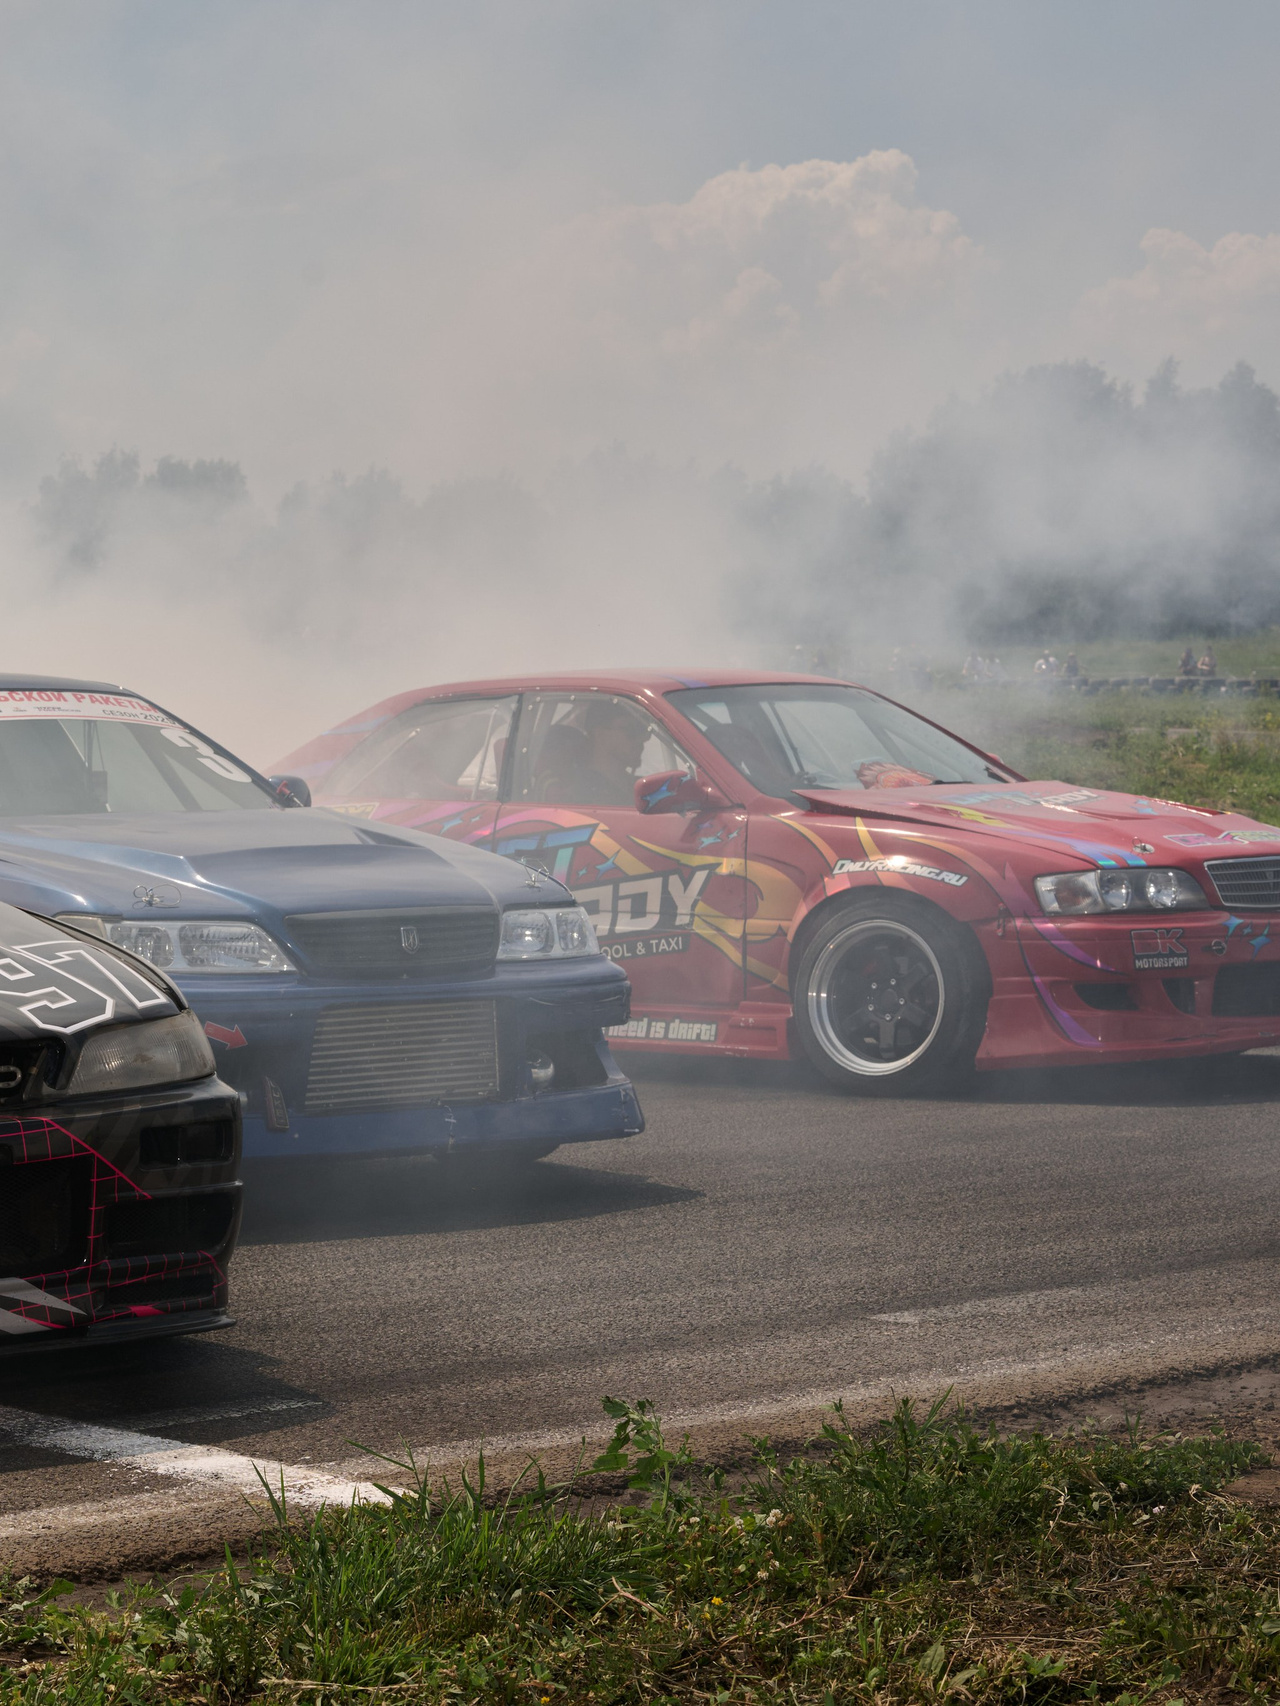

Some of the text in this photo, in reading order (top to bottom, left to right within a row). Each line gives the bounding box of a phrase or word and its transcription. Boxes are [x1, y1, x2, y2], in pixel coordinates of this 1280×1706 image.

[72, 693, 158, 713] РАКЕТЫ
[102, 709, 140, 719] СЕЗОН
[636, 941, 646, 955] &
[649, 936, 683, 954] TAXI
[1131, 928, 1188, 955] DK
[1135, 956, 1188, 969] MOTORSPORT
[649, 1021, 666, 1039] is
